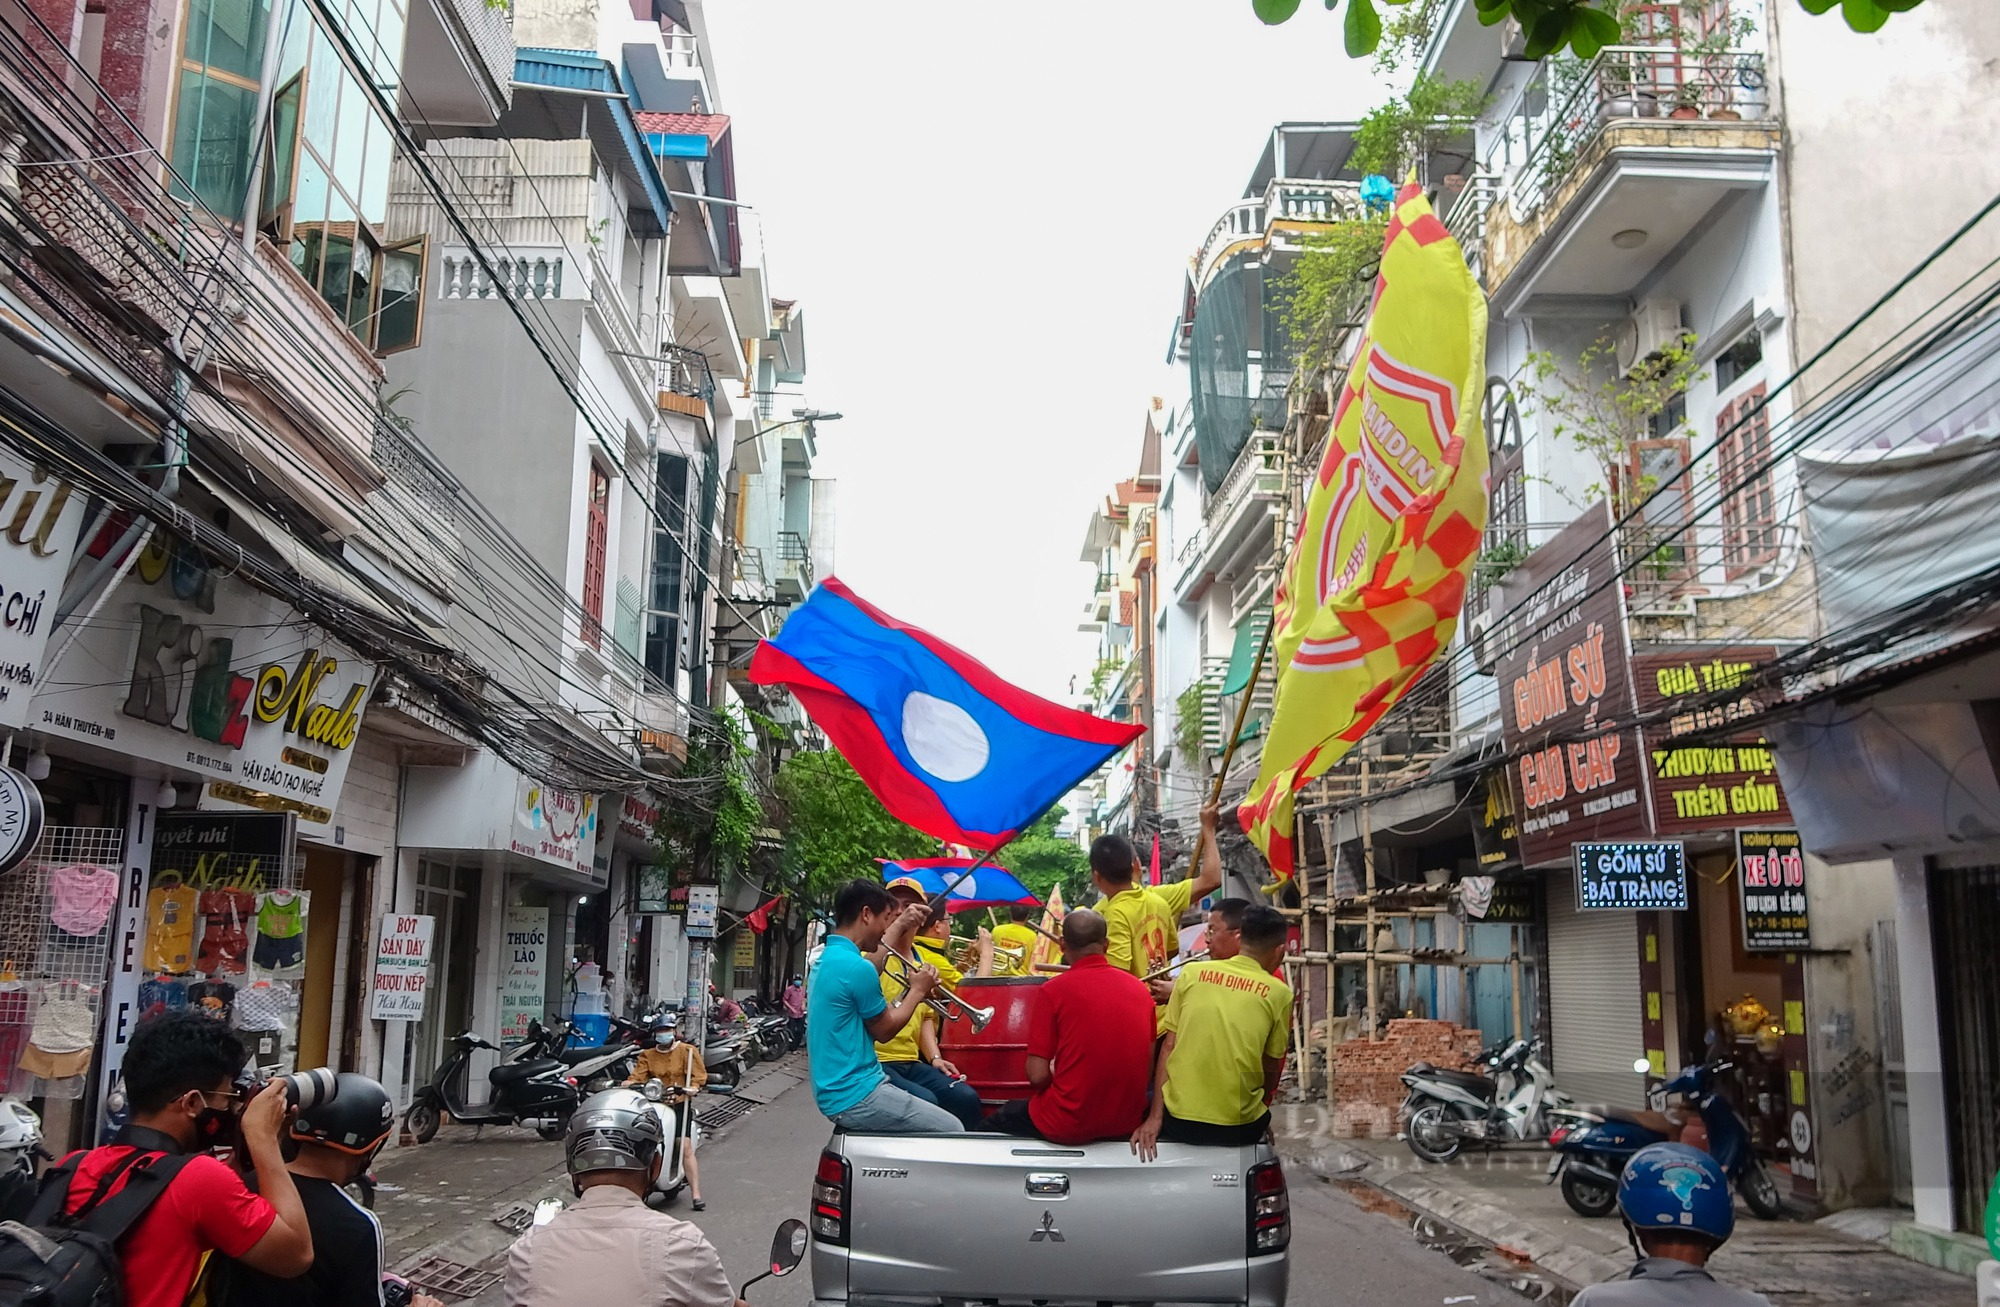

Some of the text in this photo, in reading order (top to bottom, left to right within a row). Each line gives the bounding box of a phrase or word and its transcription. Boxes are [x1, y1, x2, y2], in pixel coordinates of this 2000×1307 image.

[1513, 645, 1567, 733] GỐM
[1567, 621, 1607, 706] SỨ
[1656, 661, 1700, 697] QUÀ
[1519, 745, 1567, 810] CAO
[1568, 701, 1621, 793] CẤP
[1737, 737, 1776, 776] HIỆ
[282, 772, 301, 793] TẠO
[1672, 782, 1728, 818] TRÊN
[1730, 775, 1779, 814] GỐM
[154, 824, 195, 848] uyết
[1597, 848, 1666, 874] GỐM SỨ
[1743, 847, 1803, 887] XE Ô TÔ
[1587, 874, 1679, 900] BÁT TRÀNG
[397, 916, 418, 936] BỘT
[507, 927, 545, 945] THUỐC
[514, 947, 536, 962] LÀO
[1198, 969, 1271, 999] NAM ĐỊNH FC
[516, 1013, 528, 1026] 26
